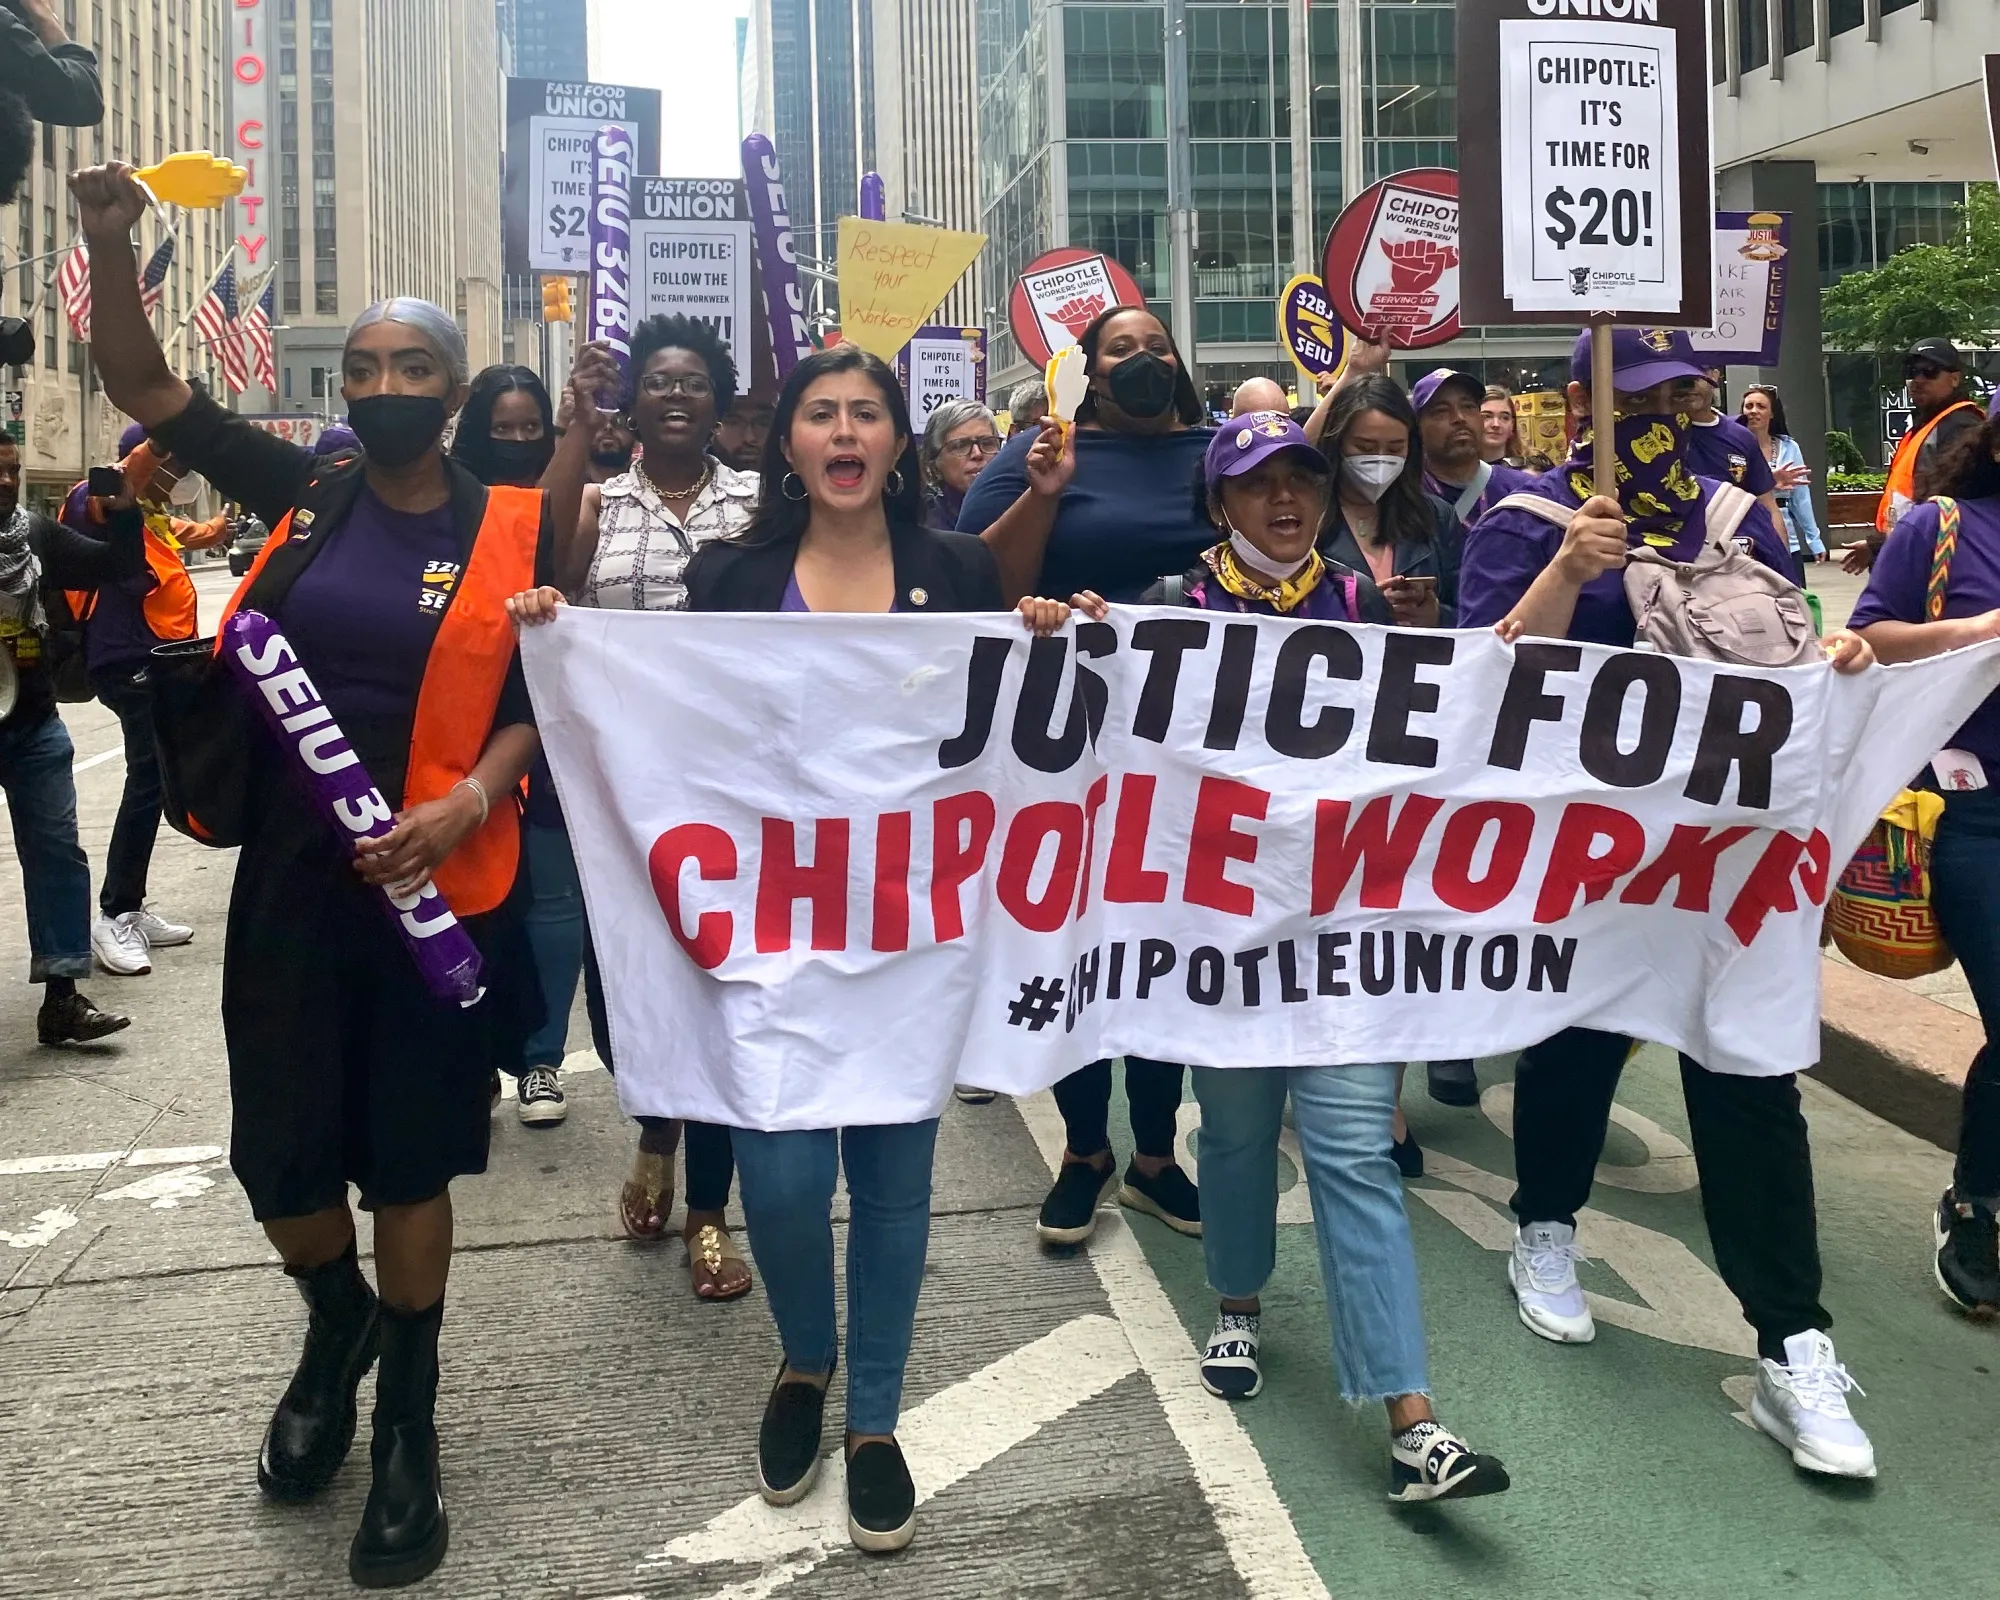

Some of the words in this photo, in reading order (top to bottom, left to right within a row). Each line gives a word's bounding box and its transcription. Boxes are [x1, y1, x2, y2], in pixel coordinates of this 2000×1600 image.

[1537, 57, 1656, 88] CHIPOTLE:
[545, 82, 582, 96] FAST
[583, 84, 626, 99] FOOD
[545, 97, 626, 119] UNION
[547, 136, 591, 154] CHIPO
[1546, 141, 1606, 167] TIME
[1612, 143, 1650, 170] FOR
[237, 119, 266, 264] CITY
[551, 181, 585, 196] TIME
[596, 136, 634, 234] SEIU
[645, 181, 685, 194] FAST
[686, 181, 734, 195] FOOD
[644, 196, 735, 219] UNION
[1389, 197, 1459, 223] CHIPOT
[549, 204, 591, 238] $2
[1386, 212, 1441, 231] WORKERS
[1545, 186, 1653, 250] $20!
[1404, 227, 1423, 236] 32BJ
[649, 242, 732, 260] CHIPOTLE:
[849, 231, 939, 269] Respect
[653, 272, 702, 286] FOLLOW
[704, 273, 728, 286] THE
[874, 271, 909, 291] your
[1033, 265, 1101, 291] CHIPOTLE
[1592, 272, 1636, 280] CHIPOTLE
[1718, 264, 1755, 280] IKE
[1036, 284, 1077, 299] WORKERS
[1077, 277, 1103, 289] UNION
[595, 241, 632, 358] 32BJ
[651, 294, 667, 303] NYC
[668, 294, 685, 303] FAIR
[686, 295, 730, 304] WORKWEEK
[1374, 295, 1419, 304] SERVING
[1420, 296, 1435, 304] UP
[1377, 315, 1419, 323] JUSTICE
[1295, 336, 1333, 366] SEIU
[924, 378, 943, 388] TIME
[945, 379, 960, 388] FOR
[424, 560, 460, 578] 32
[418, 592, 447, 609] SE
[419, 605, 439, 617] Stron
[237, 635, 360, 775] SEIU
[939, 618, 1455, 773] JUSTICE
[1487, 643, 1793, 810] FOR
[1008, 931, 1578, 1033] #CHIPOTLEUNION
